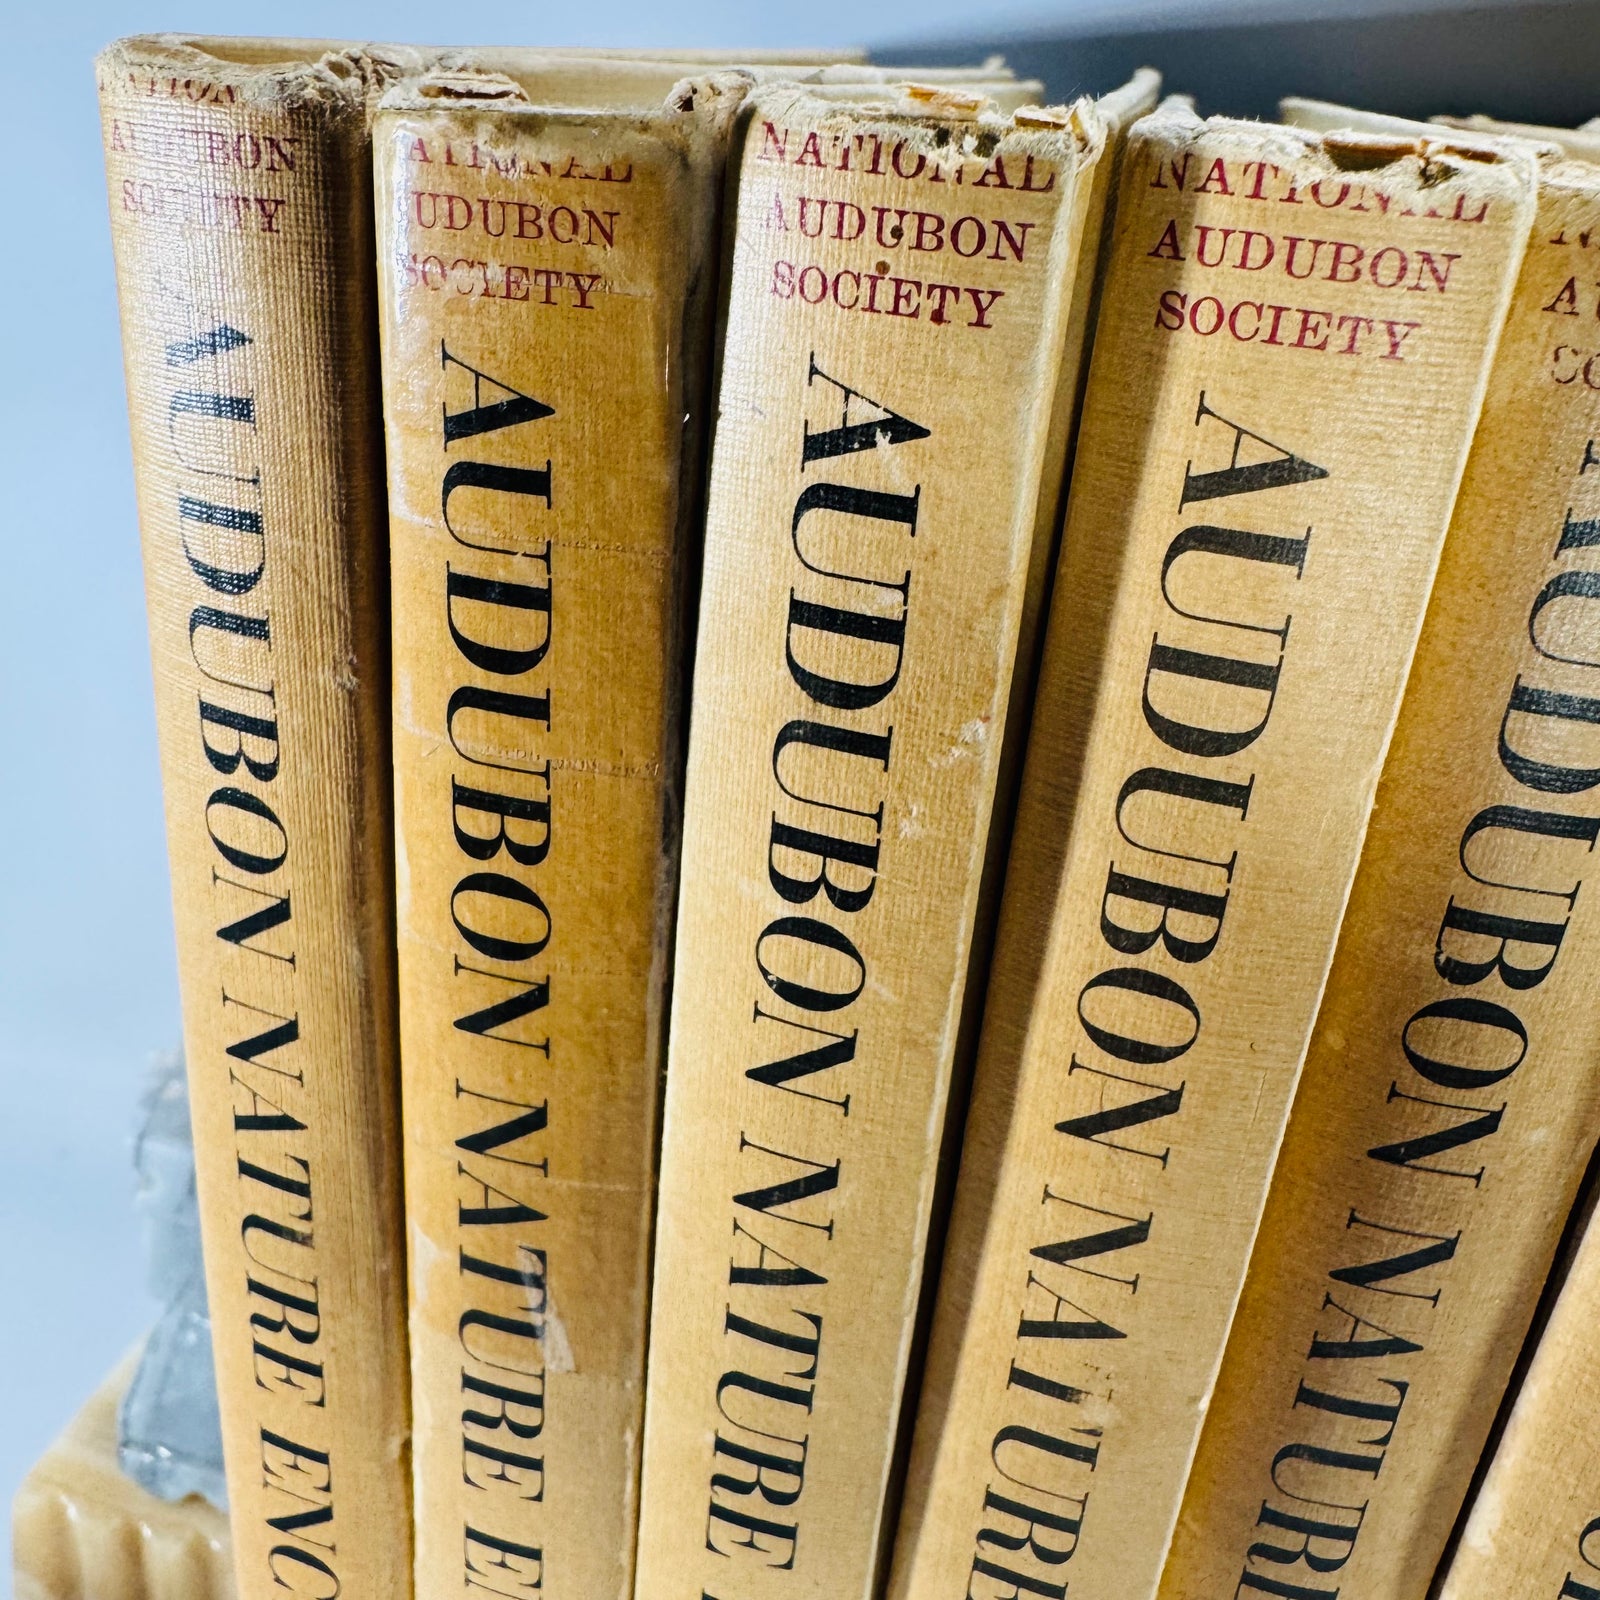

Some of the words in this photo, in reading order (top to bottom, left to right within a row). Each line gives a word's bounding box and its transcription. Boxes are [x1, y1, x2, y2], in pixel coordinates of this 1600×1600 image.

[411, 190, 621, 249] UDUBON
[763, 191, 1036, 263] AUDUBON
[770, 259, 1005, 329] SOCIETY
[1147, 218, 1462, 294] AUDUBON
[1153, 289, 1422, 361] SOCIETY
[440, 340, 557, 1060] AUDUBON
[744, 350, 932, 1118] AUDUBON
[1054, 389, 1331, 1170] AUDUBON
[221, 985, 327, 1408] NATURE
[454, 1077, 549, 1503] NATURE
[704, 1130, 842, 1572] NATURE
